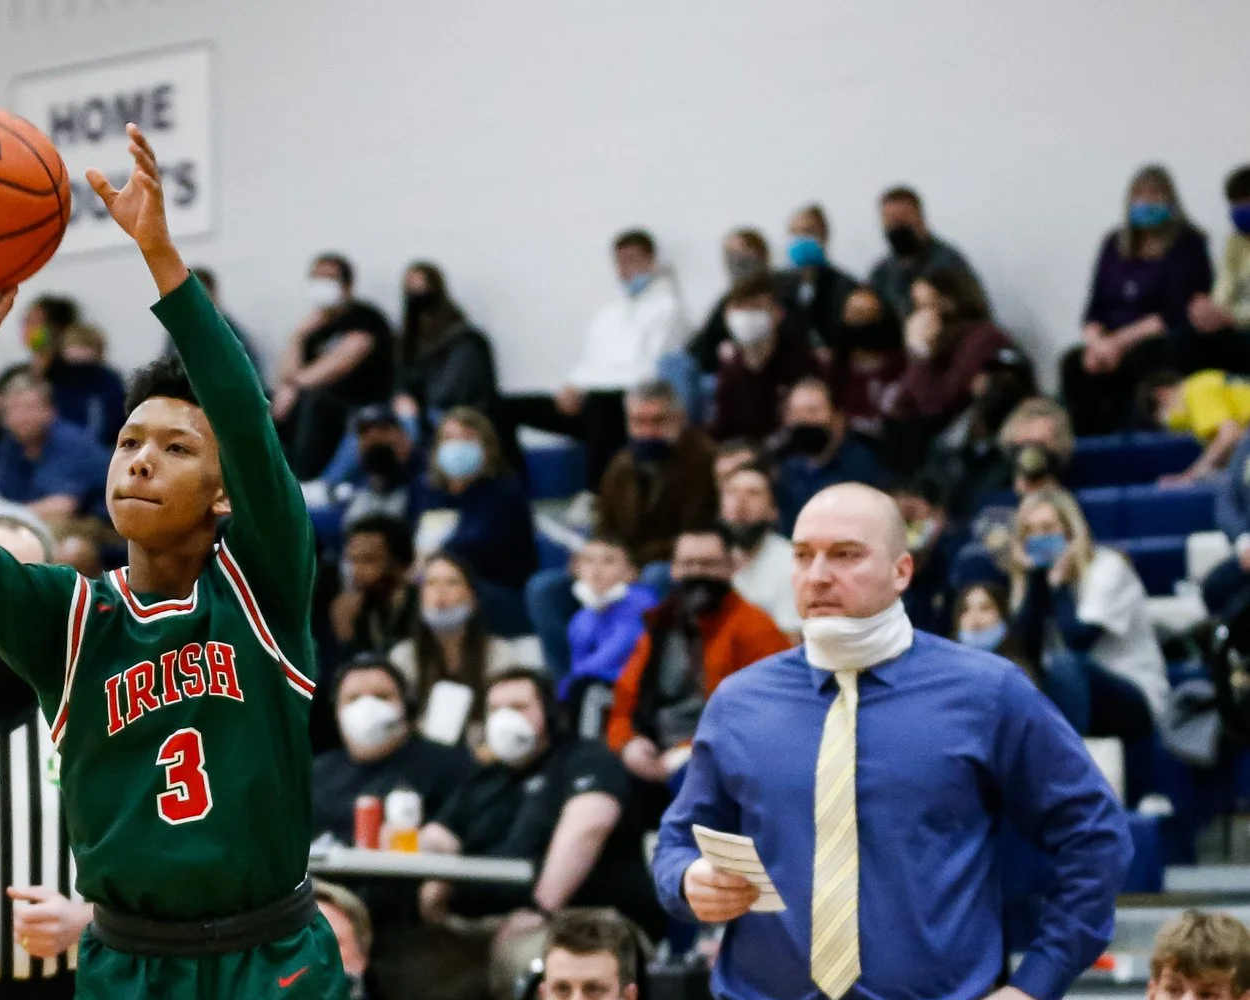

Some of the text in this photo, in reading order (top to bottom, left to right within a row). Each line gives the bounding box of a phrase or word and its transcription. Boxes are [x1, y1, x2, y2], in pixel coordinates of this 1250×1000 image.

[49, 82, 175, 146] HOME
[104, 641, 245, 737] IRISH
[156, 727, 214, 826] 3
